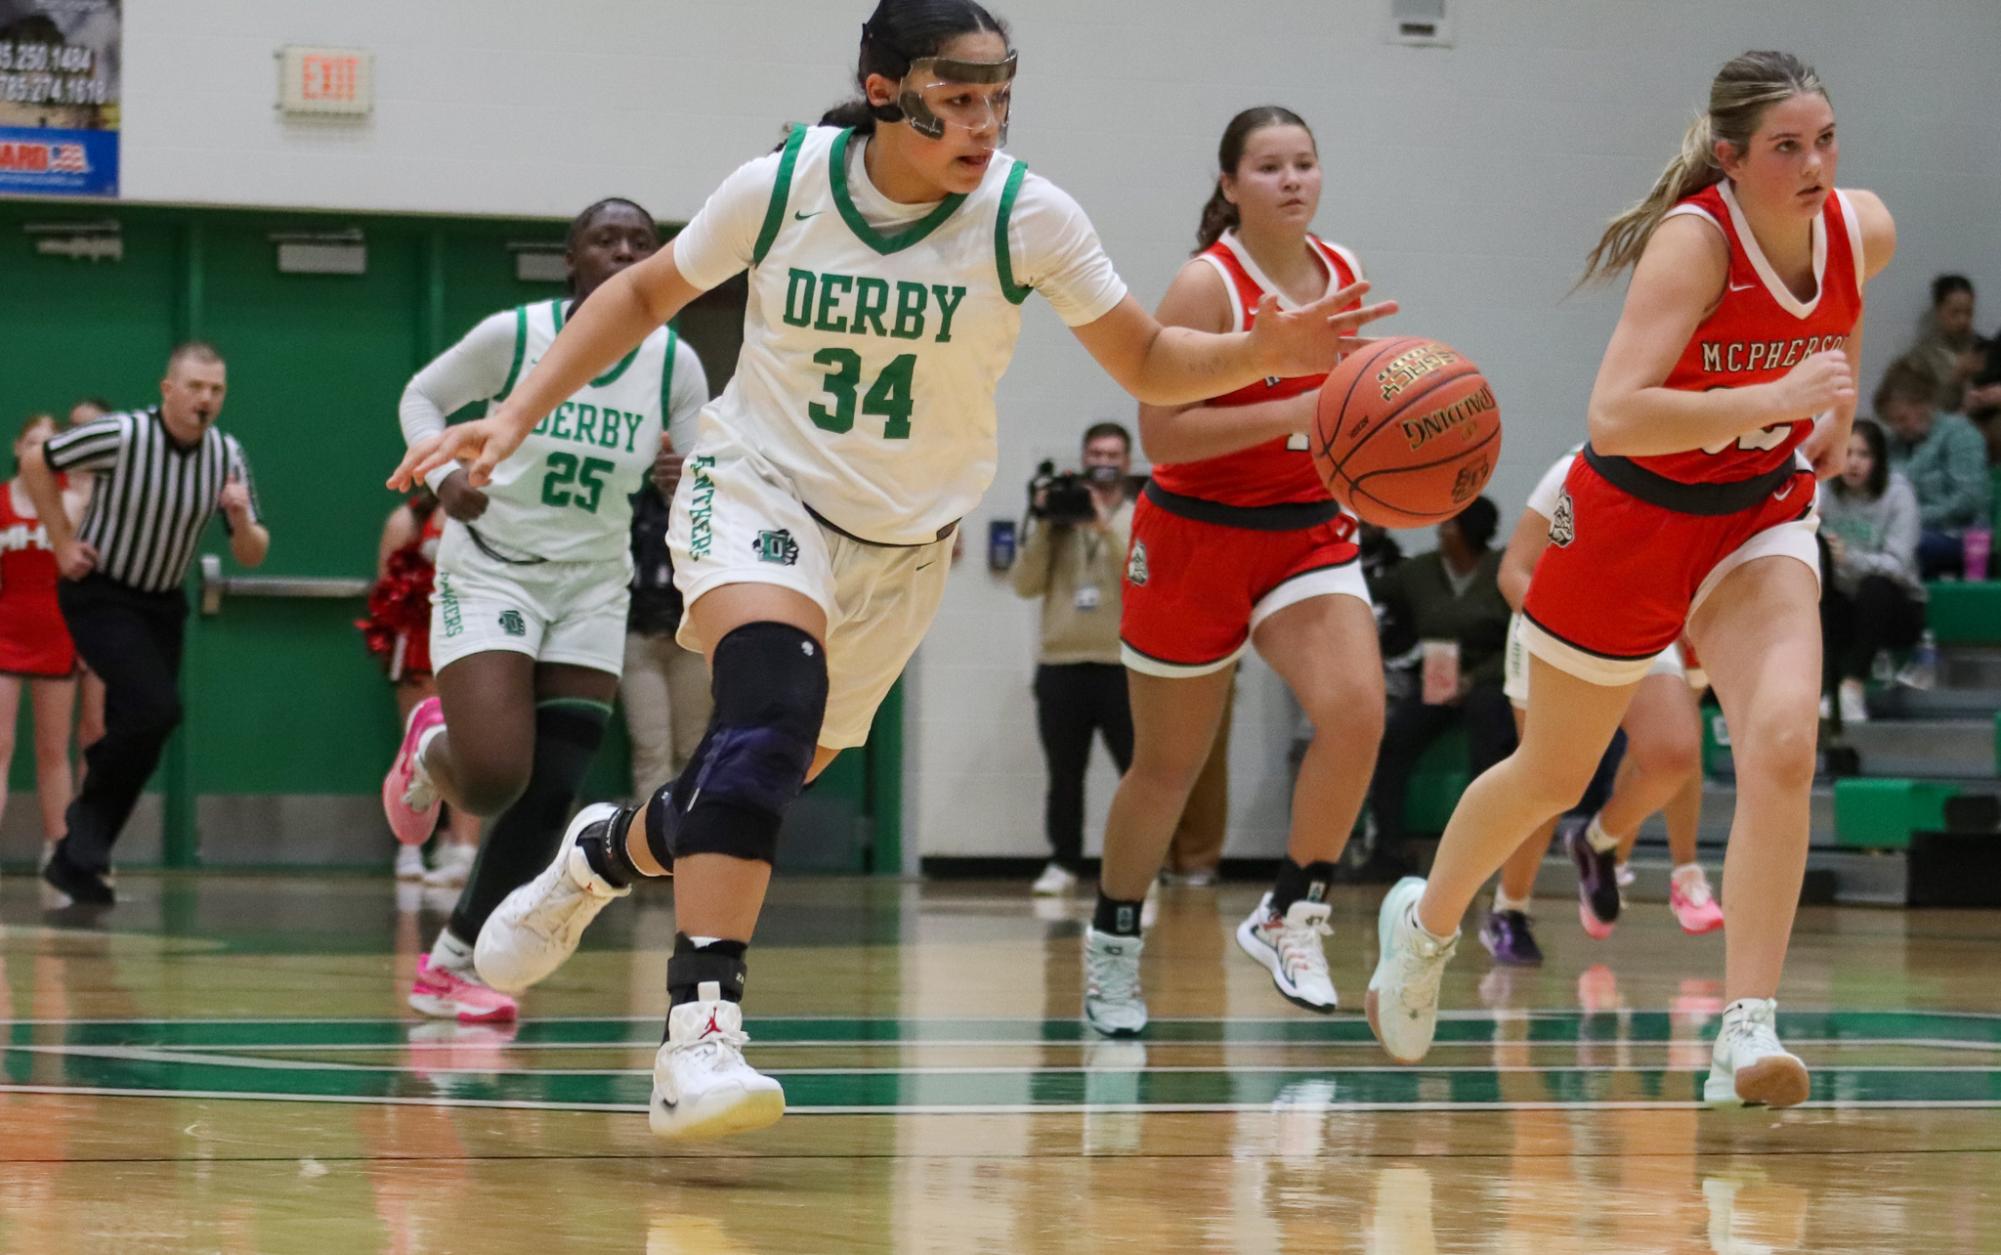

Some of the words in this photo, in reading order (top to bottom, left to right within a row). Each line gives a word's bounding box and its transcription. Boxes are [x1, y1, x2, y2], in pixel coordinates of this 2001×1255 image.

[303, 54, 358, 101] EXIT
[784, 267, 967, 343] DERBY
[1379, 349, 1457, 404] EGACY
[1701, 334, 1845, 373] MCPHERSO
[808, 347, 917, 440] 34
[541, 450, 616, 515] 25
